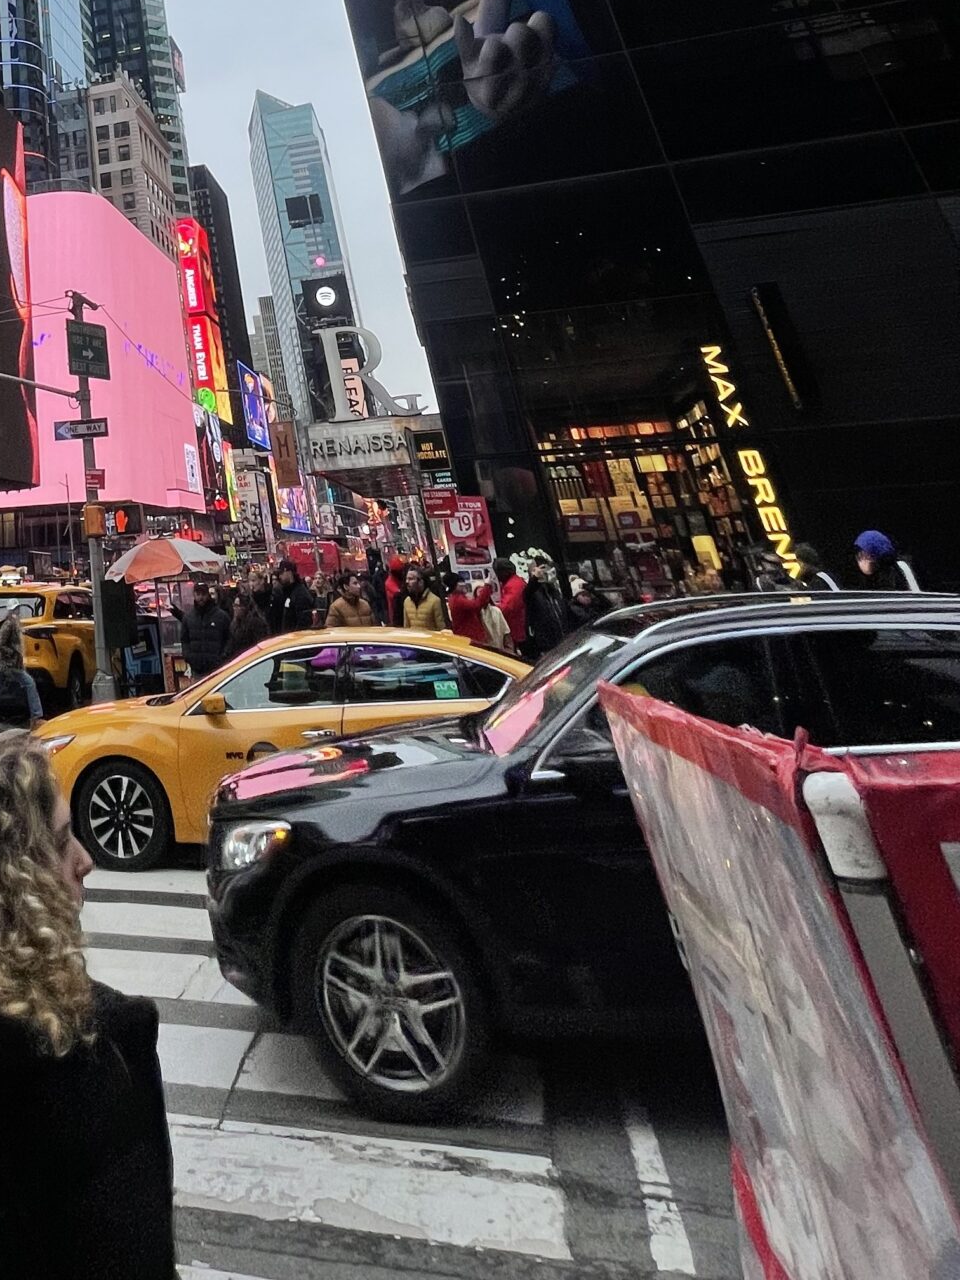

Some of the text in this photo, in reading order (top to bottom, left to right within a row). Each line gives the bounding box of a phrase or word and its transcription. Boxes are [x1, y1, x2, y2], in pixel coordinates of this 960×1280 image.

[312, 325, 429, 423] R
[700, 345, 749, 428] MAX
[64, 423, 102, 434] ONE WAY
[310, 431, 409, 459] RENAISSA
[421, 442, 434, 451] HOT
